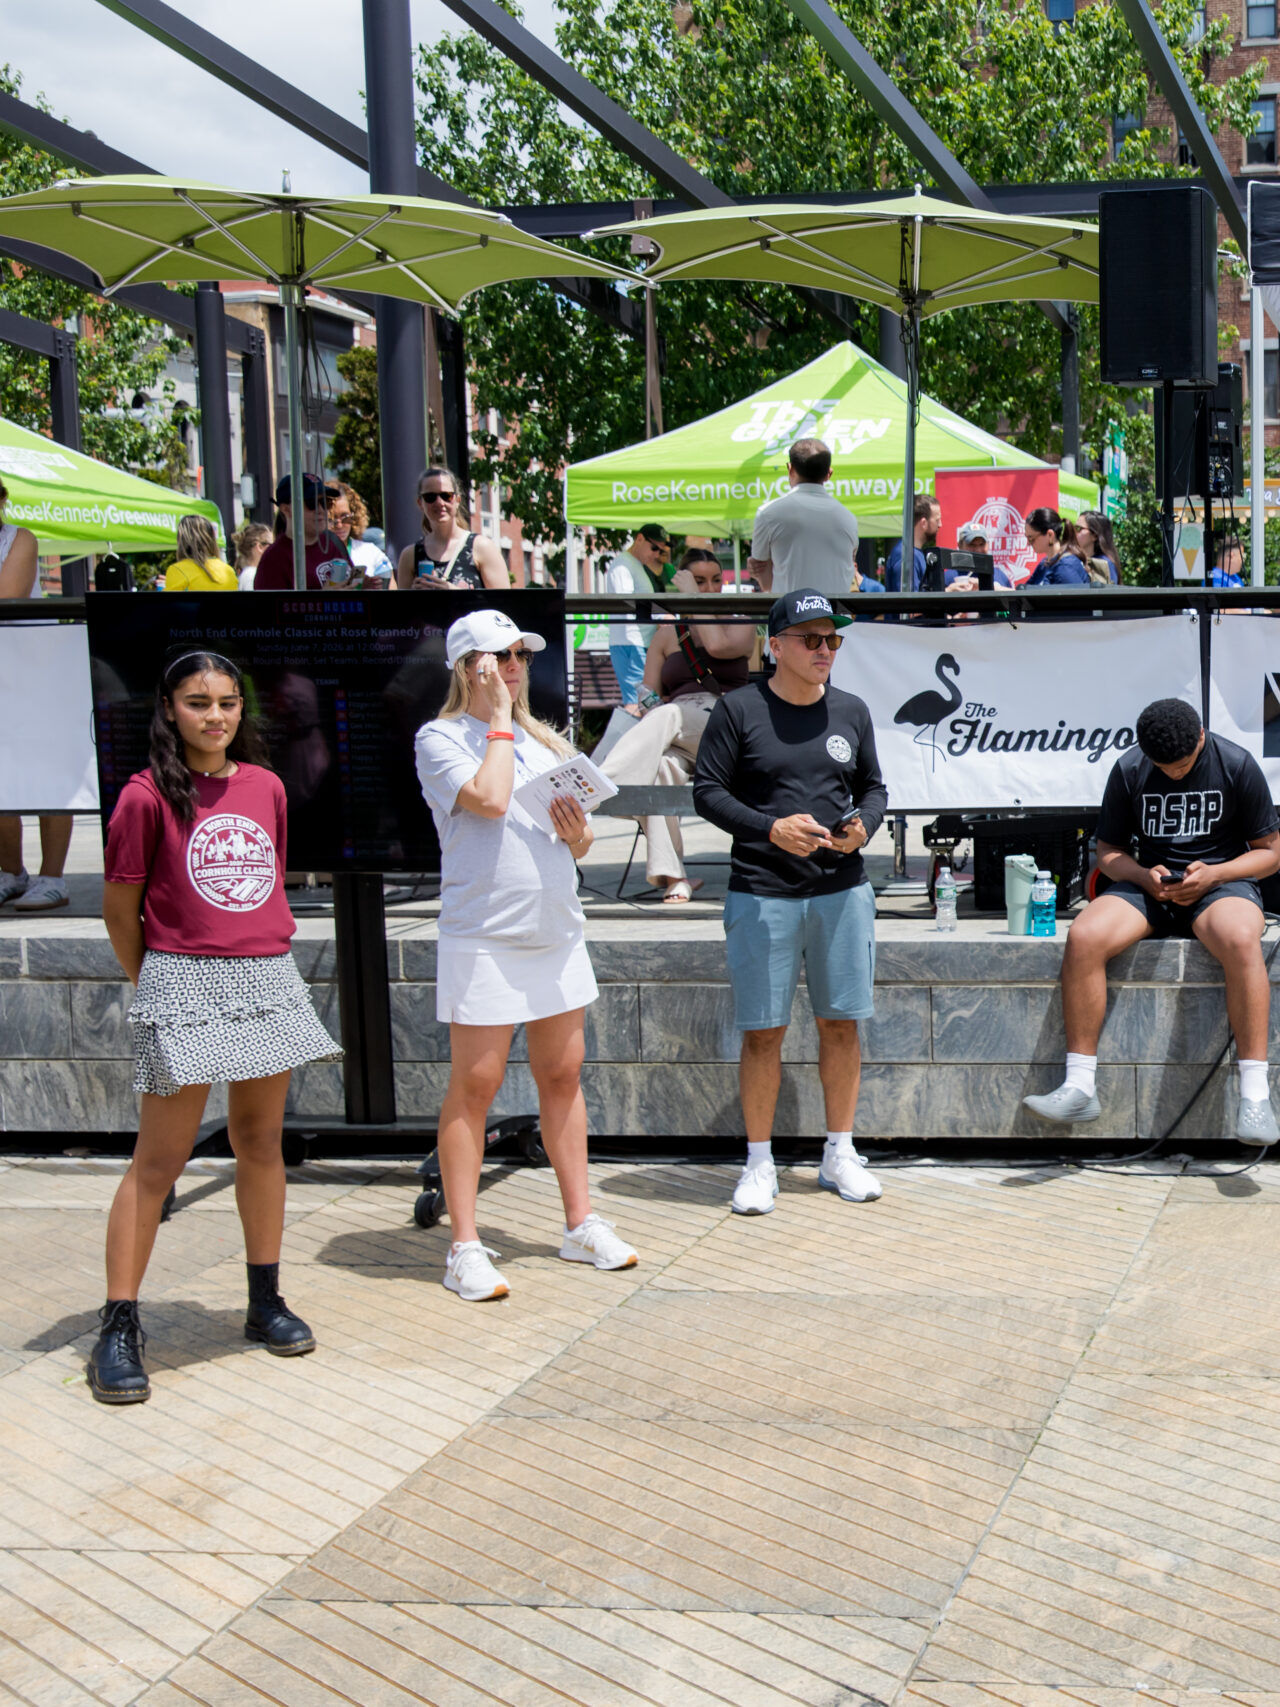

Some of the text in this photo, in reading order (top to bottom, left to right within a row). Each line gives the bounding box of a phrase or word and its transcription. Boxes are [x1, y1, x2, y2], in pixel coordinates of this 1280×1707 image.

[169, 627, 203, 639] North
[206, 627, 228, 639] End
[230, 627, 281, 639] Cornhole
[284, 627, 323, 638] Classic
[325, 628, 338, 638] at
[341, 627, 368, 638] Rose
[370, 626, 420, 640] Kennedy
[964, 702, 998, 718] The
[947, 718, 1138, 763] Flamingo
[204, 818, 257, 833] NORTH END
[194, 865, 274, 879] CORNHOLE CLASSIC
